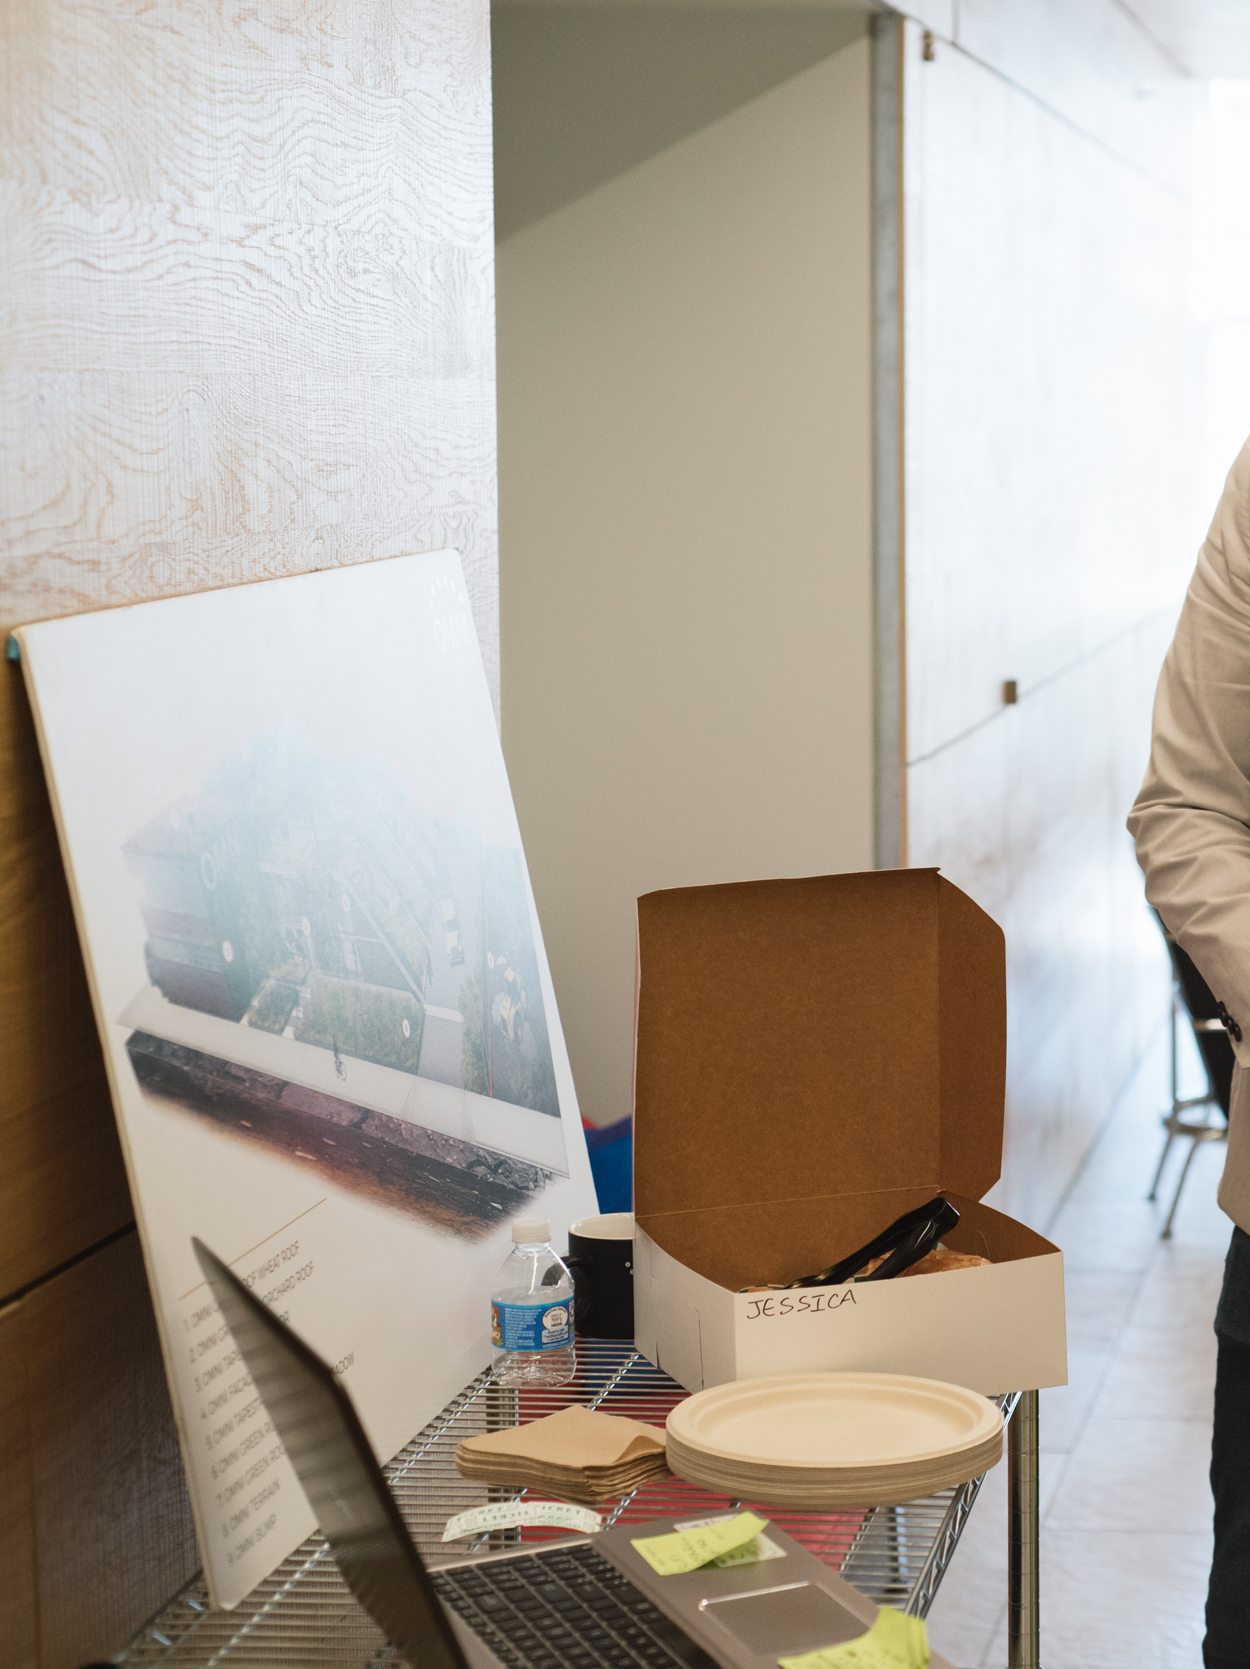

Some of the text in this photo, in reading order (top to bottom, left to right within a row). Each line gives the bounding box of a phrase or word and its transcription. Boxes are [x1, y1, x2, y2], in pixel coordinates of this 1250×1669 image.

[433, 611, 472, 653] OMNI
[191, 1305, 213, 1328] OMNI
[257, 1253, 281, 1281] WHEAT
[280, 1240, 299, 1262] ROOF
[746, 1289, 857, 1320] JESSICA
[196, 1332, 218, 1358] OMNI
[262, 1274, 296, 1306] ORCHARD
[294, 1260, 314, 1282] ROOF
[202, 1363, 224, 1387] OMNI
[207, 1391, 229, 1416] OMNI
[228, 1374, 252, 1396] FACAD
[212, 1419, 234, 1445] OMNI
[233, 1398, 261, 1427] TAPEST
[218, 1447, 240, 1474] OMNI
[239, 1428, 264, 1457] GREEN
[223, 1477, 245, 1503] OMNI
[244, 1456, 270, 1485] GREEN
[269, 1446, 286, 1462] ROO
[229, 1504, 251, 1532] OMNI
[249, 1478, 281, 1512] TERRAIN
[234, 1535, 256, 1561] OMNI
[254, 1512, 277, 1543] BUMP
